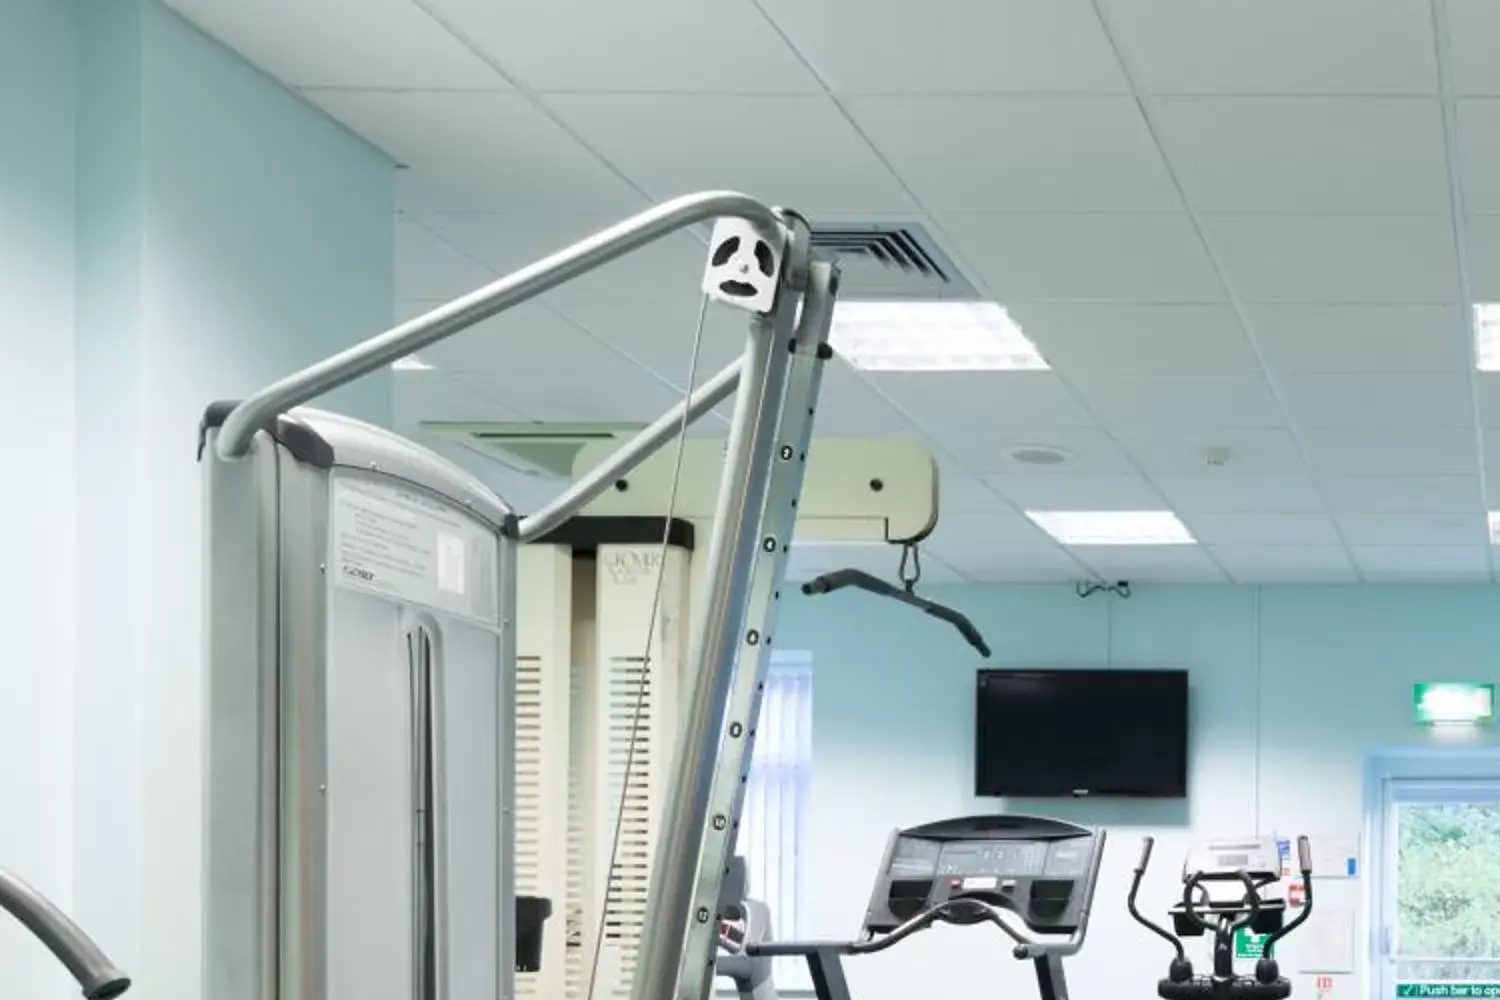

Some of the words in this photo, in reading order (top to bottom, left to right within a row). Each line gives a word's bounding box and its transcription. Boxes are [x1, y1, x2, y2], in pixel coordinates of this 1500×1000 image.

[1420, 984, 1448, 995] Push
[1450, 984, 1467, 995] bar
[1471, 984, 1482, 995] to
